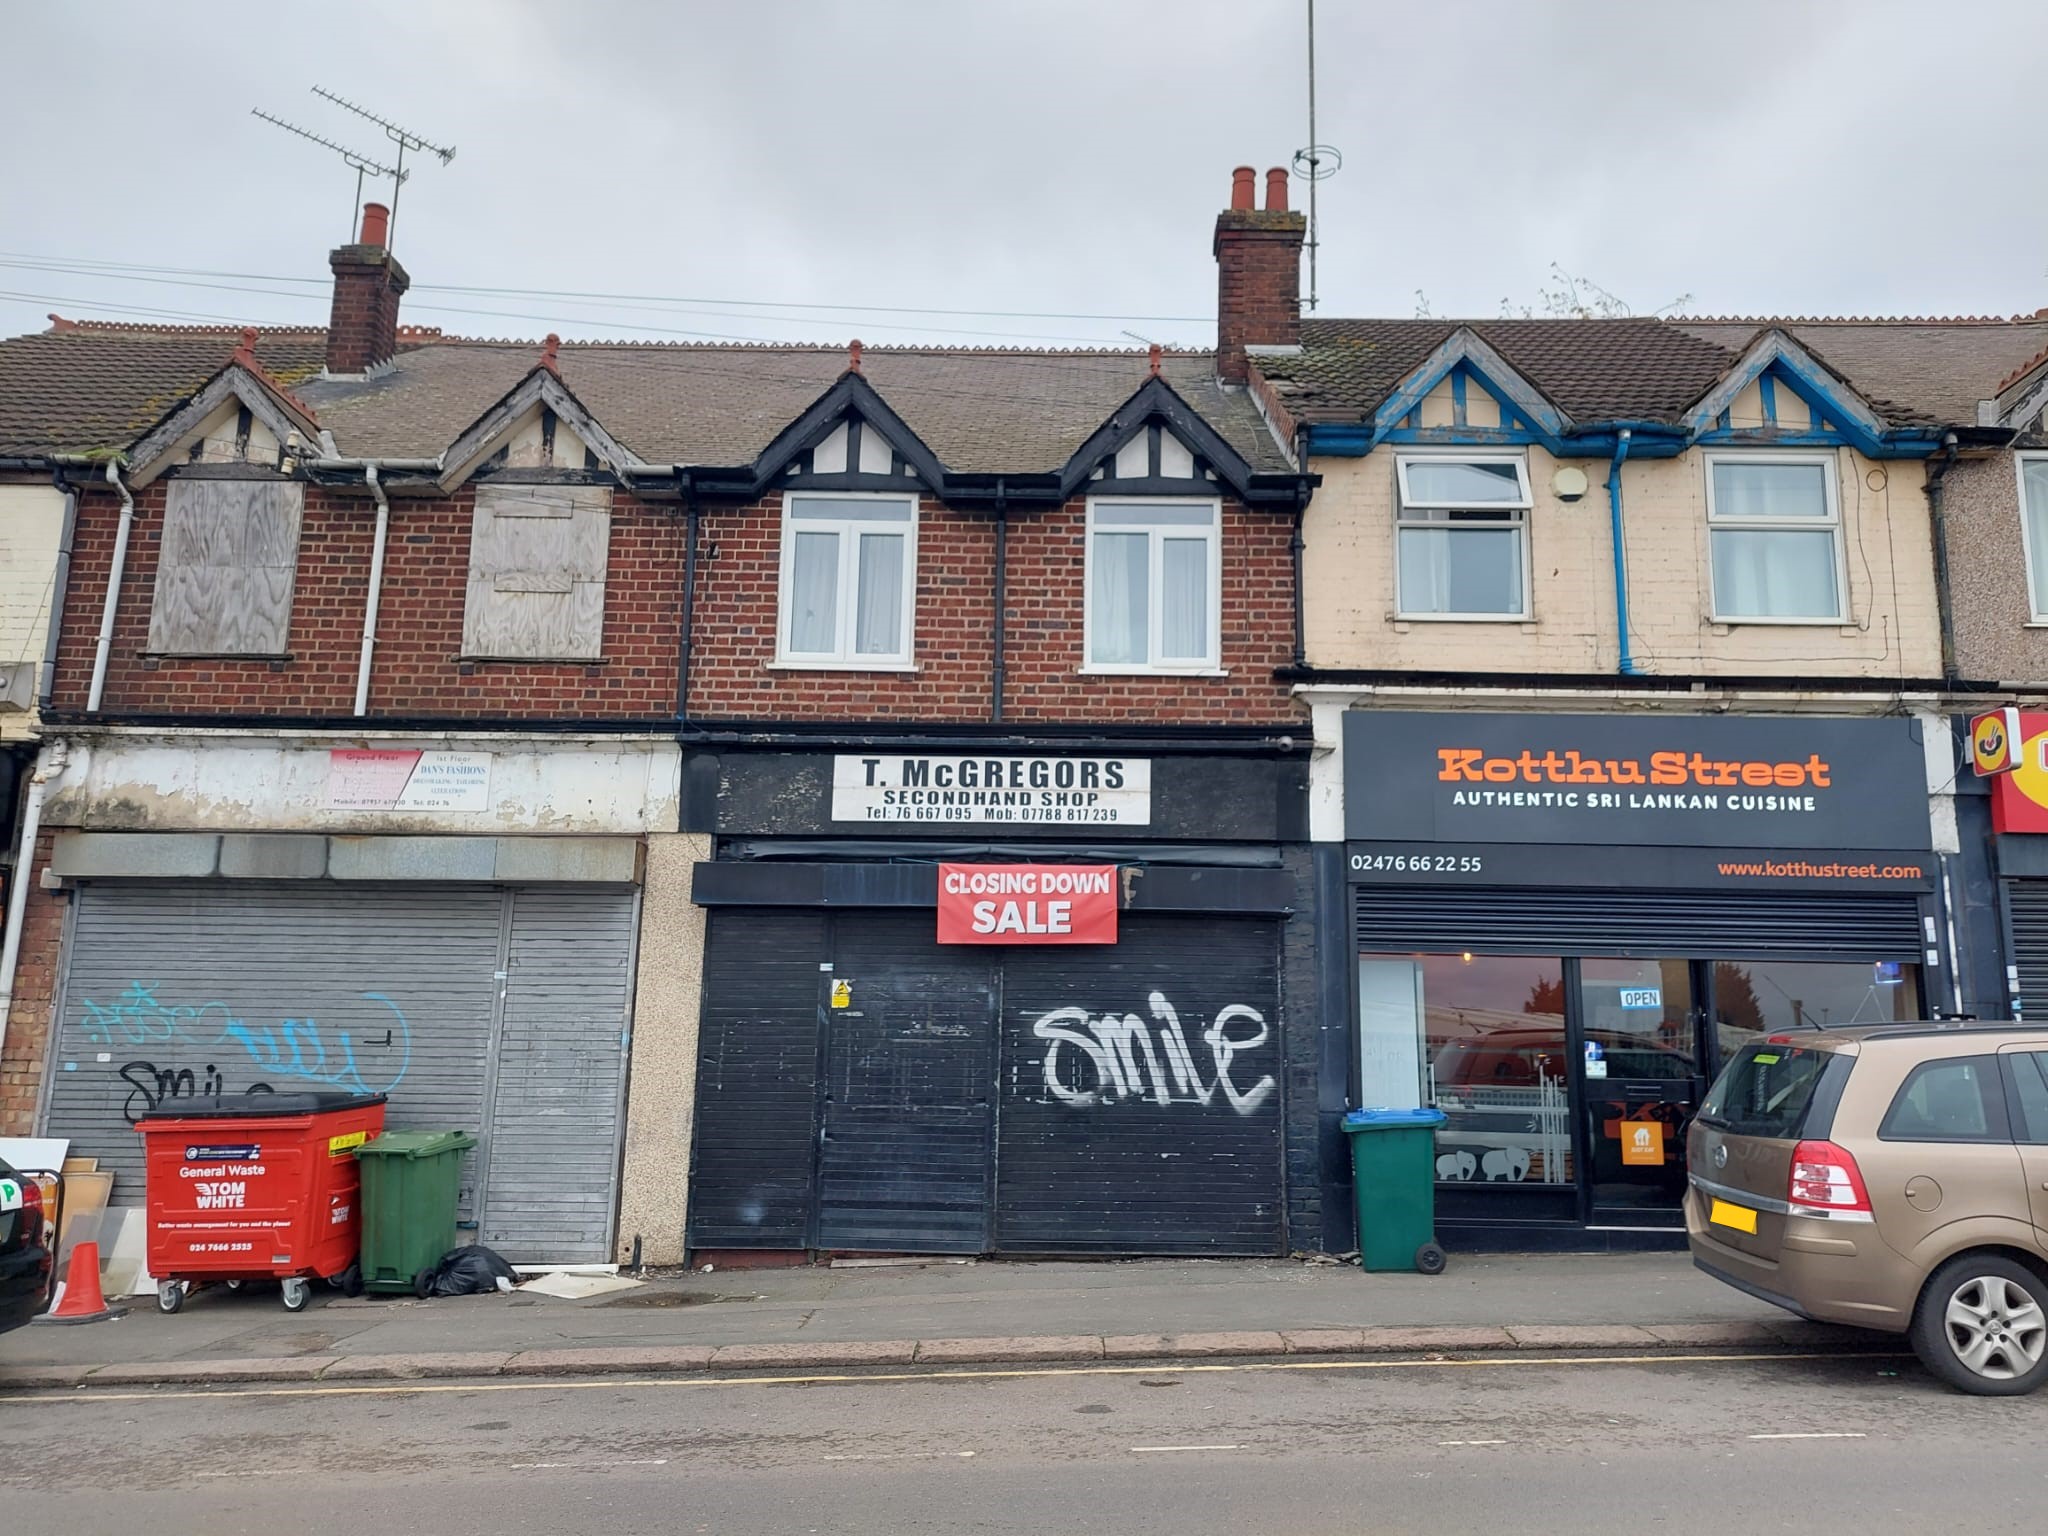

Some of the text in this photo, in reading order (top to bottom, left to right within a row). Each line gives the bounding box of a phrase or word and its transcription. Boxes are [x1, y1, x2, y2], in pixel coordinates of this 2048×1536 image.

[446, 766, 487, 775] FASHIONS
[862, 759, 1125, 789] T. McGREGORS
[1437, 748, 1832, 788] Kotthu Street
[884, 790, 1099, 807] SECONDHAND SHOP
[1453, 791, 1816, 812] AUTHENTIC SRI LANKAN CUISINE
[866, 806, 1118, 821] Tel: 76 667 095 Mob: 07788 817 239
[1351, 855, 1482, 872] 02476 66 22 55
[1717, 860, 1921, 879] www.kotthustreet.com
[944, 872, 1110, 895] CLOSING DOWN
[971, 901, 1073, 935] SALE
[1625, 991, 1658, 1006] OPEN
[179, 1164, 266, 1179] General Waste
[207, 1181, 246, 1195] TOM
[196, 1195, 246, 1209] WHITE
